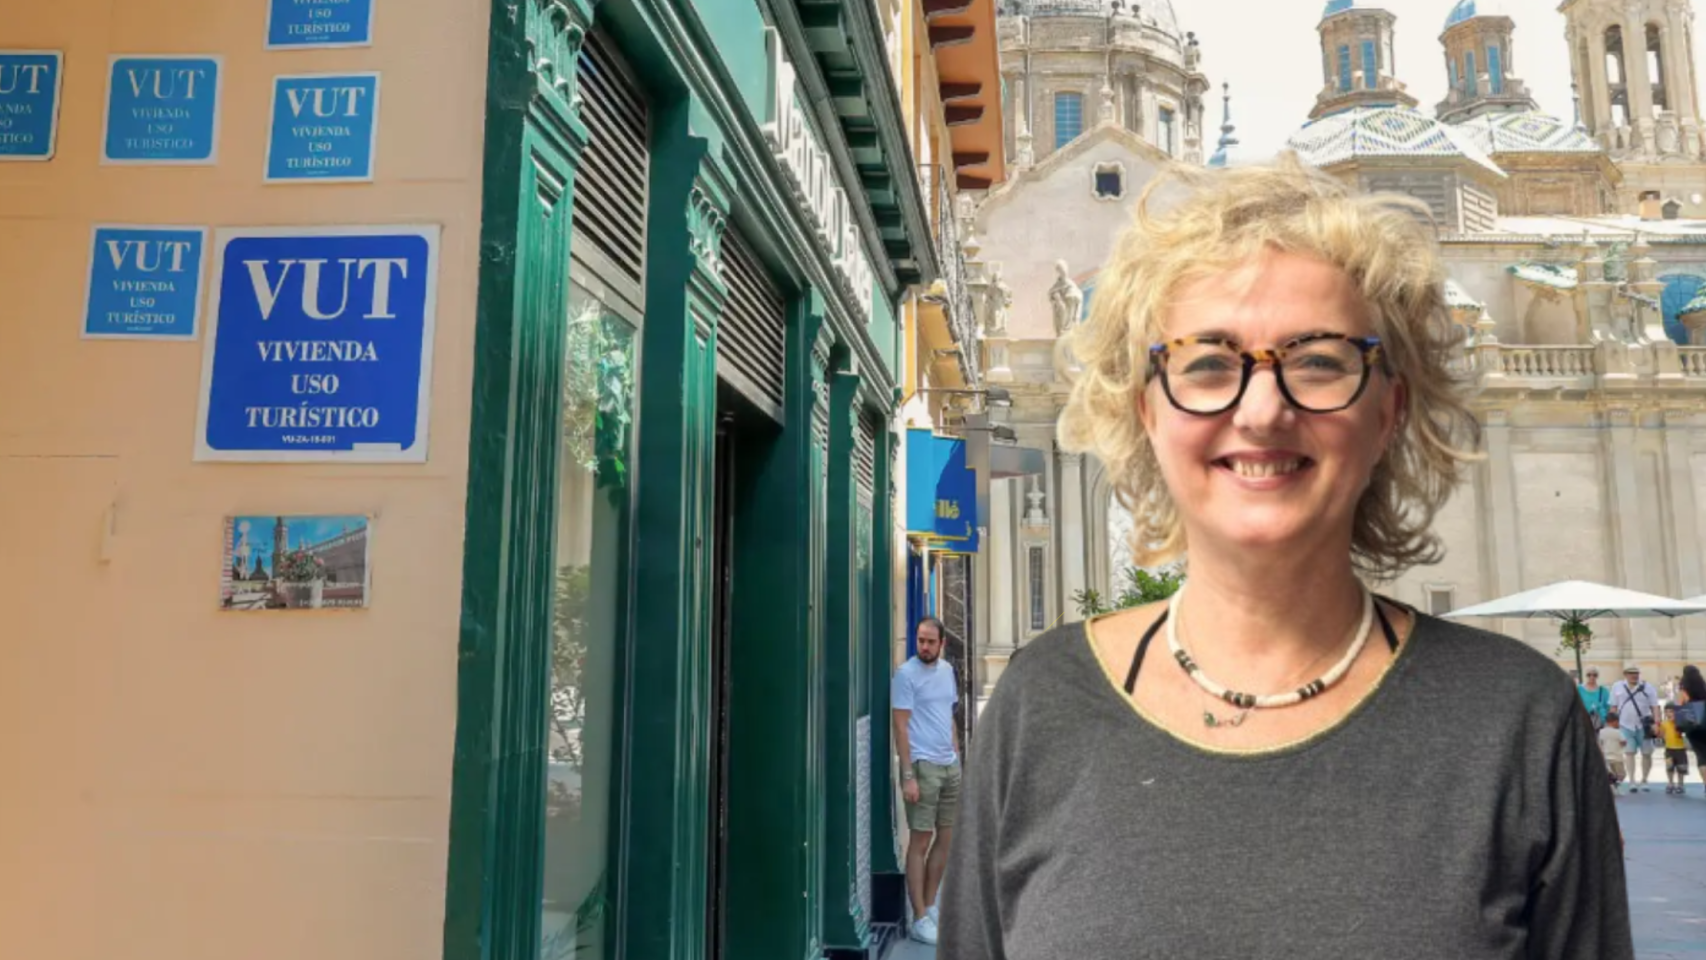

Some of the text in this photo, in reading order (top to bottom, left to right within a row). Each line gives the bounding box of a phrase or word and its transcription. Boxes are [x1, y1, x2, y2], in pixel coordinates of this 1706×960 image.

[127, 69, 206, 99] VUT
[285, 86, 366, 118] VUT
[131, 107, 191, 119] VIVIENDA
[147, 123, 174, 135] USO
[291, 126, 351, 138] VIVIENDA
[308, 142, 332, 153] USO
[105, 239, 191, 273] VUT
[112, 279, 176, 292] VIVIENDA
[242, 258, 408, 321] VUT
[130, 296, 156, 308] USO
[257, 340, 378, 362] VIVIENDA
[291, 374, 339, 394] USO
[245, 401, 379, 428] TURÍSTICO
